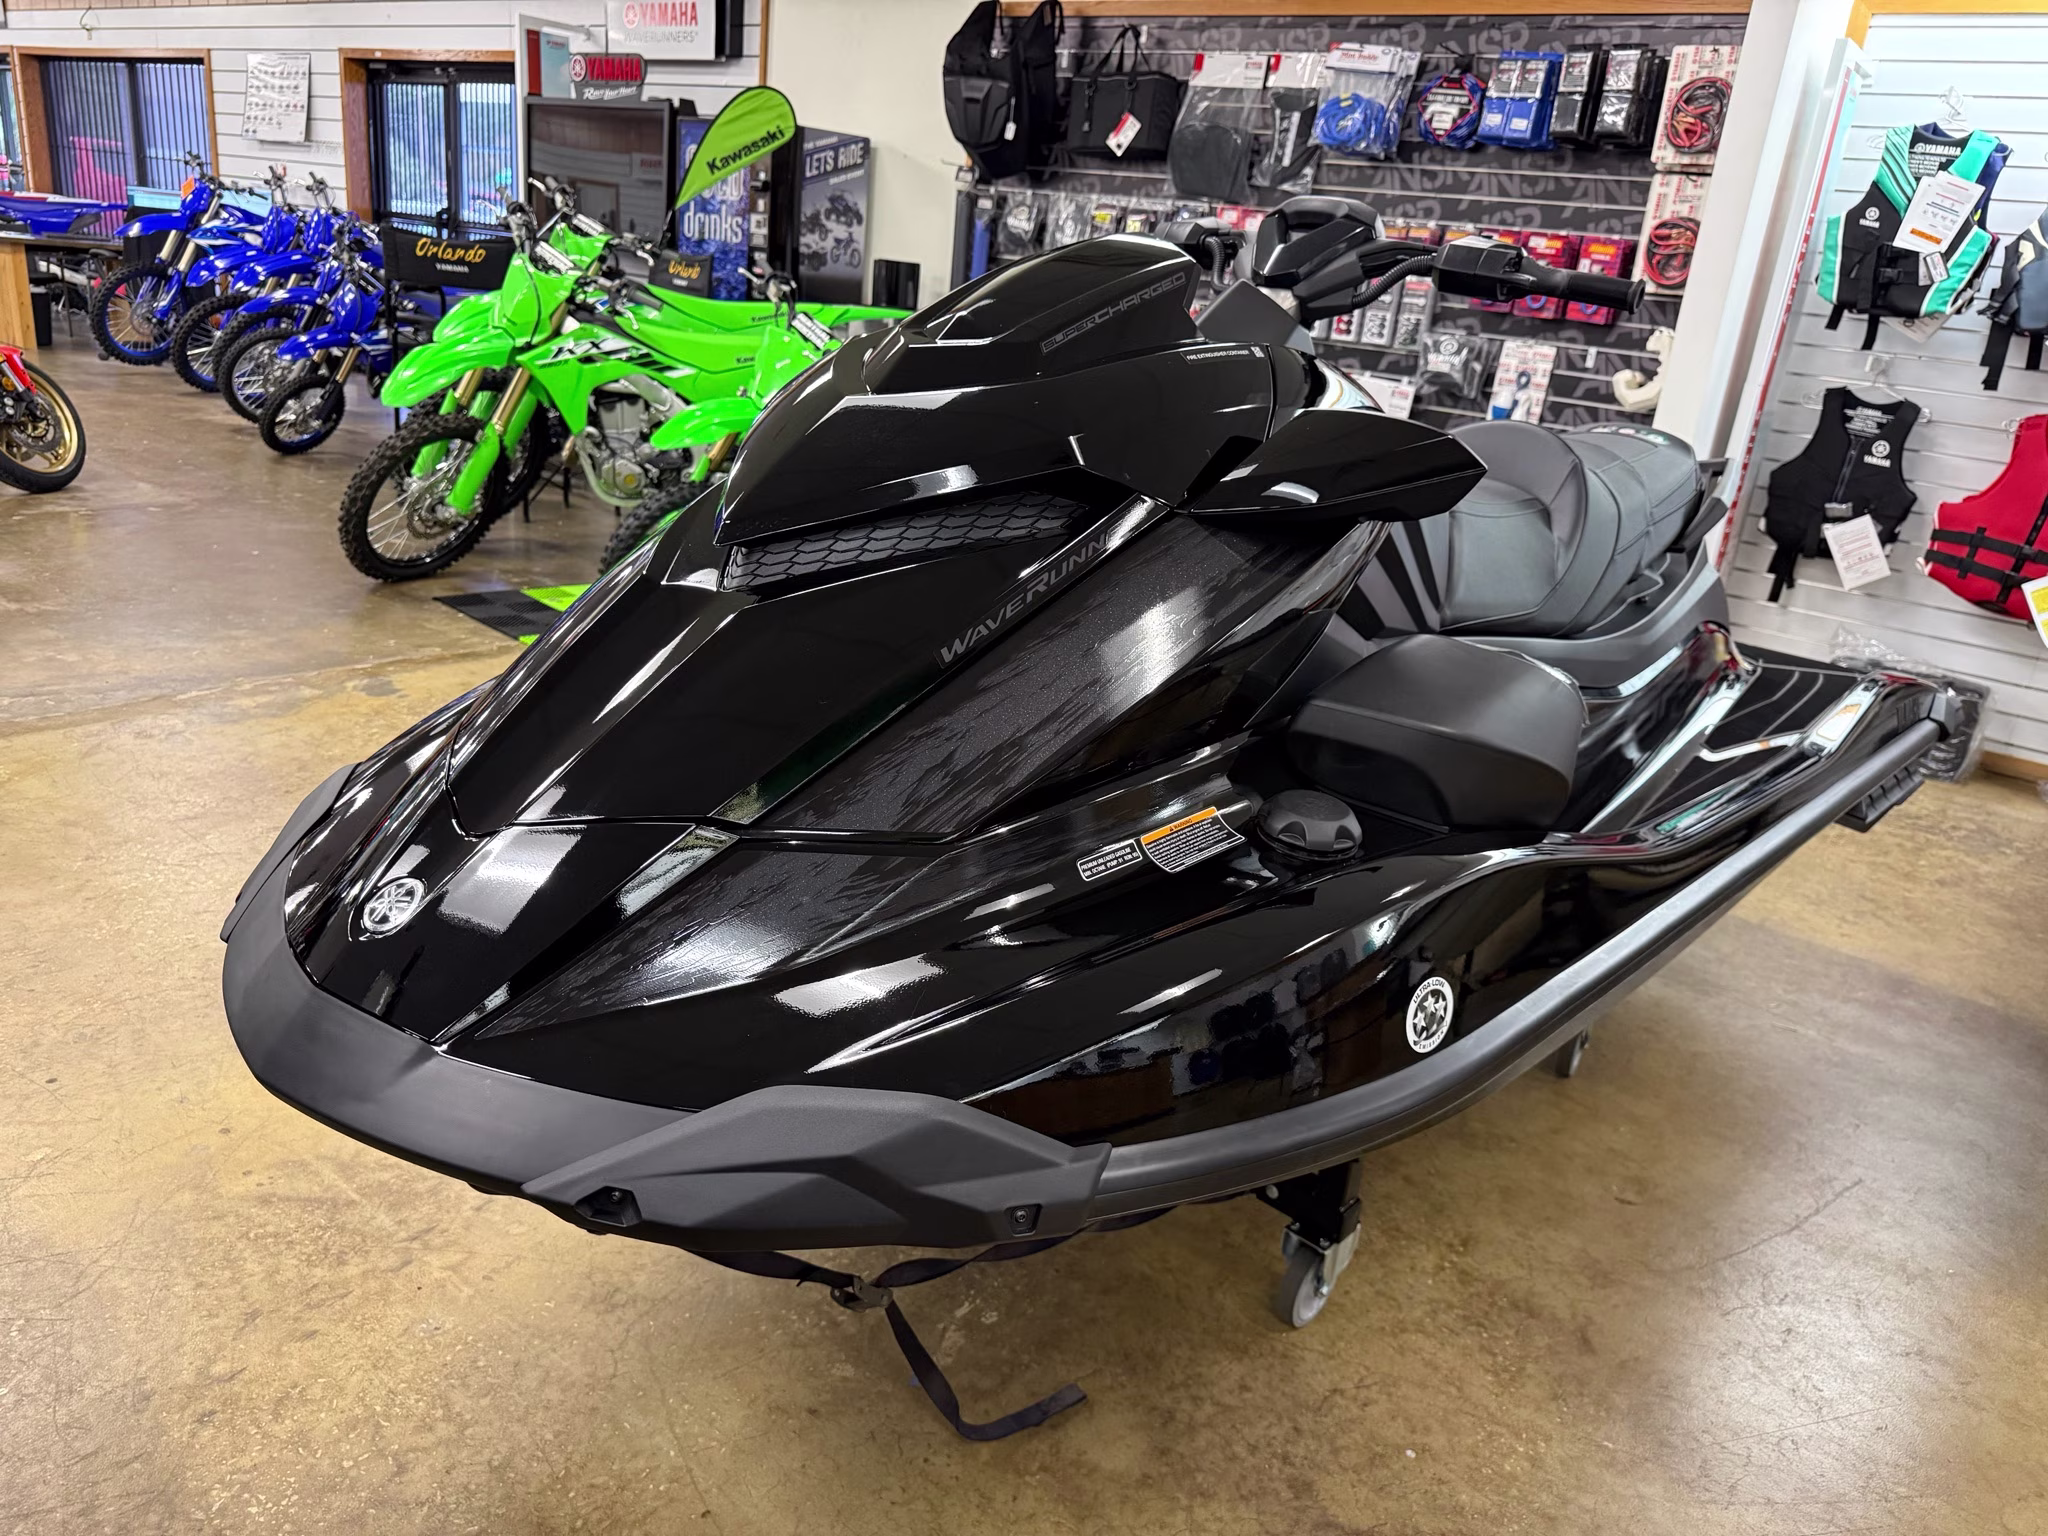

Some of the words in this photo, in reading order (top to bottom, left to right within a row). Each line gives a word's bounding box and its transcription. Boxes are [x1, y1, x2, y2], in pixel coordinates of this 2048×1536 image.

[640, 1, 698, 27] YAMAHA
[586, 57, 642, 82] YAMAHA
[706, 125, 785, 175] Kawasaki
[837, 141, 865, 170] RIDE
[684, 200, 743, 244] drinks
[415, 237, 487, 263] Orlando
[1041, 271, 1187, 355] SUPERCHARGED
[1413, 981, 1432, 1004] ULTRA
[1431, 979, 1446, 988] LOW
